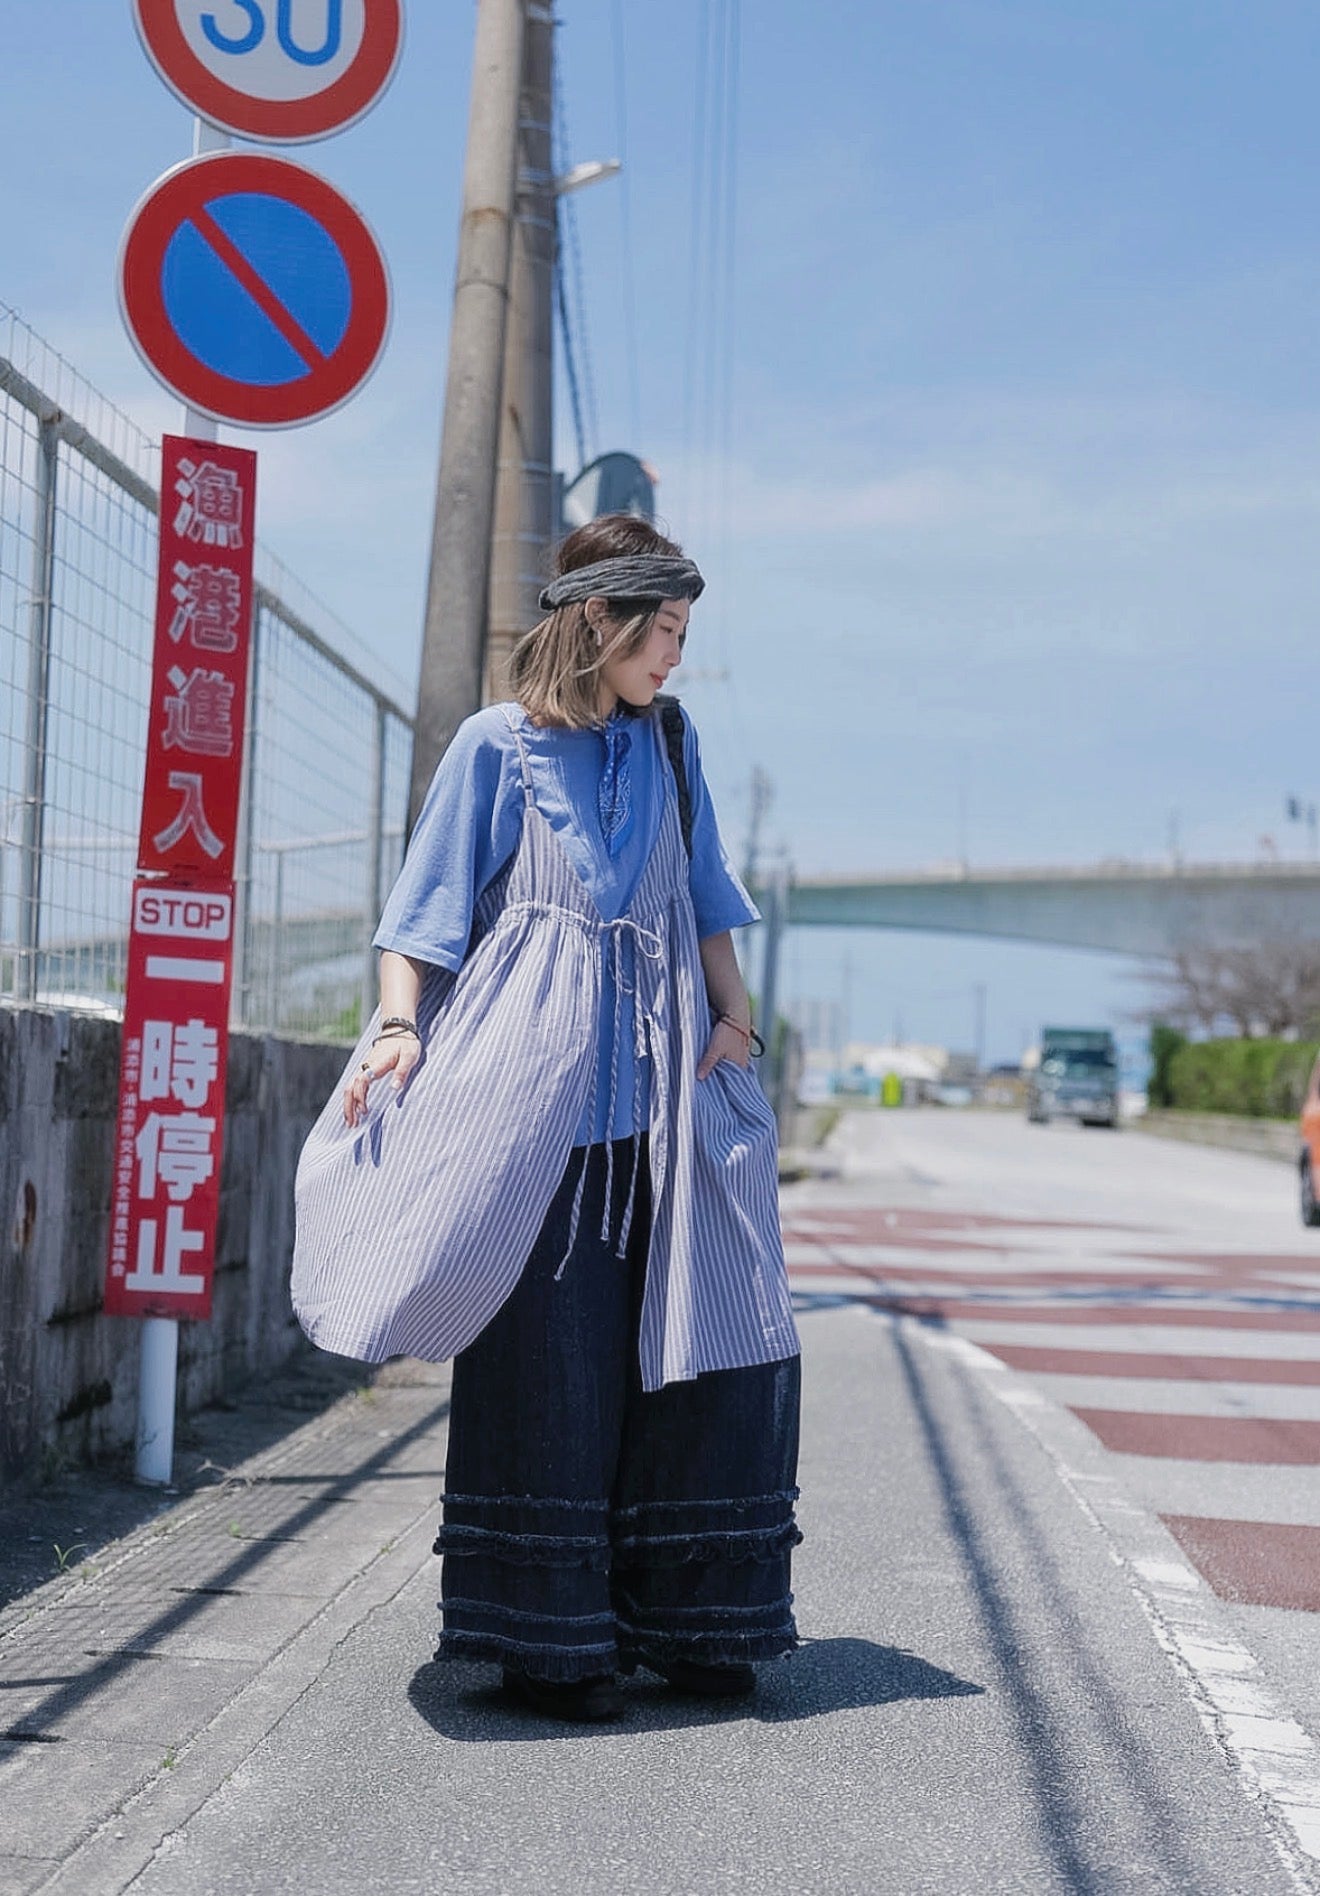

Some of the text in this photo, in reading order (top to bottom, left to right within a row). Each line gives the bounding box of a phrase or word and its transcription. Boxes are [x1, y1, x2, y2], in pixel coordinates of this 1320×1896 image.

[152, 457, 245, 860] 漁港進入
[140, 897, 225, 930] STOP
[125, 954, 225, 1294] 一時停止
